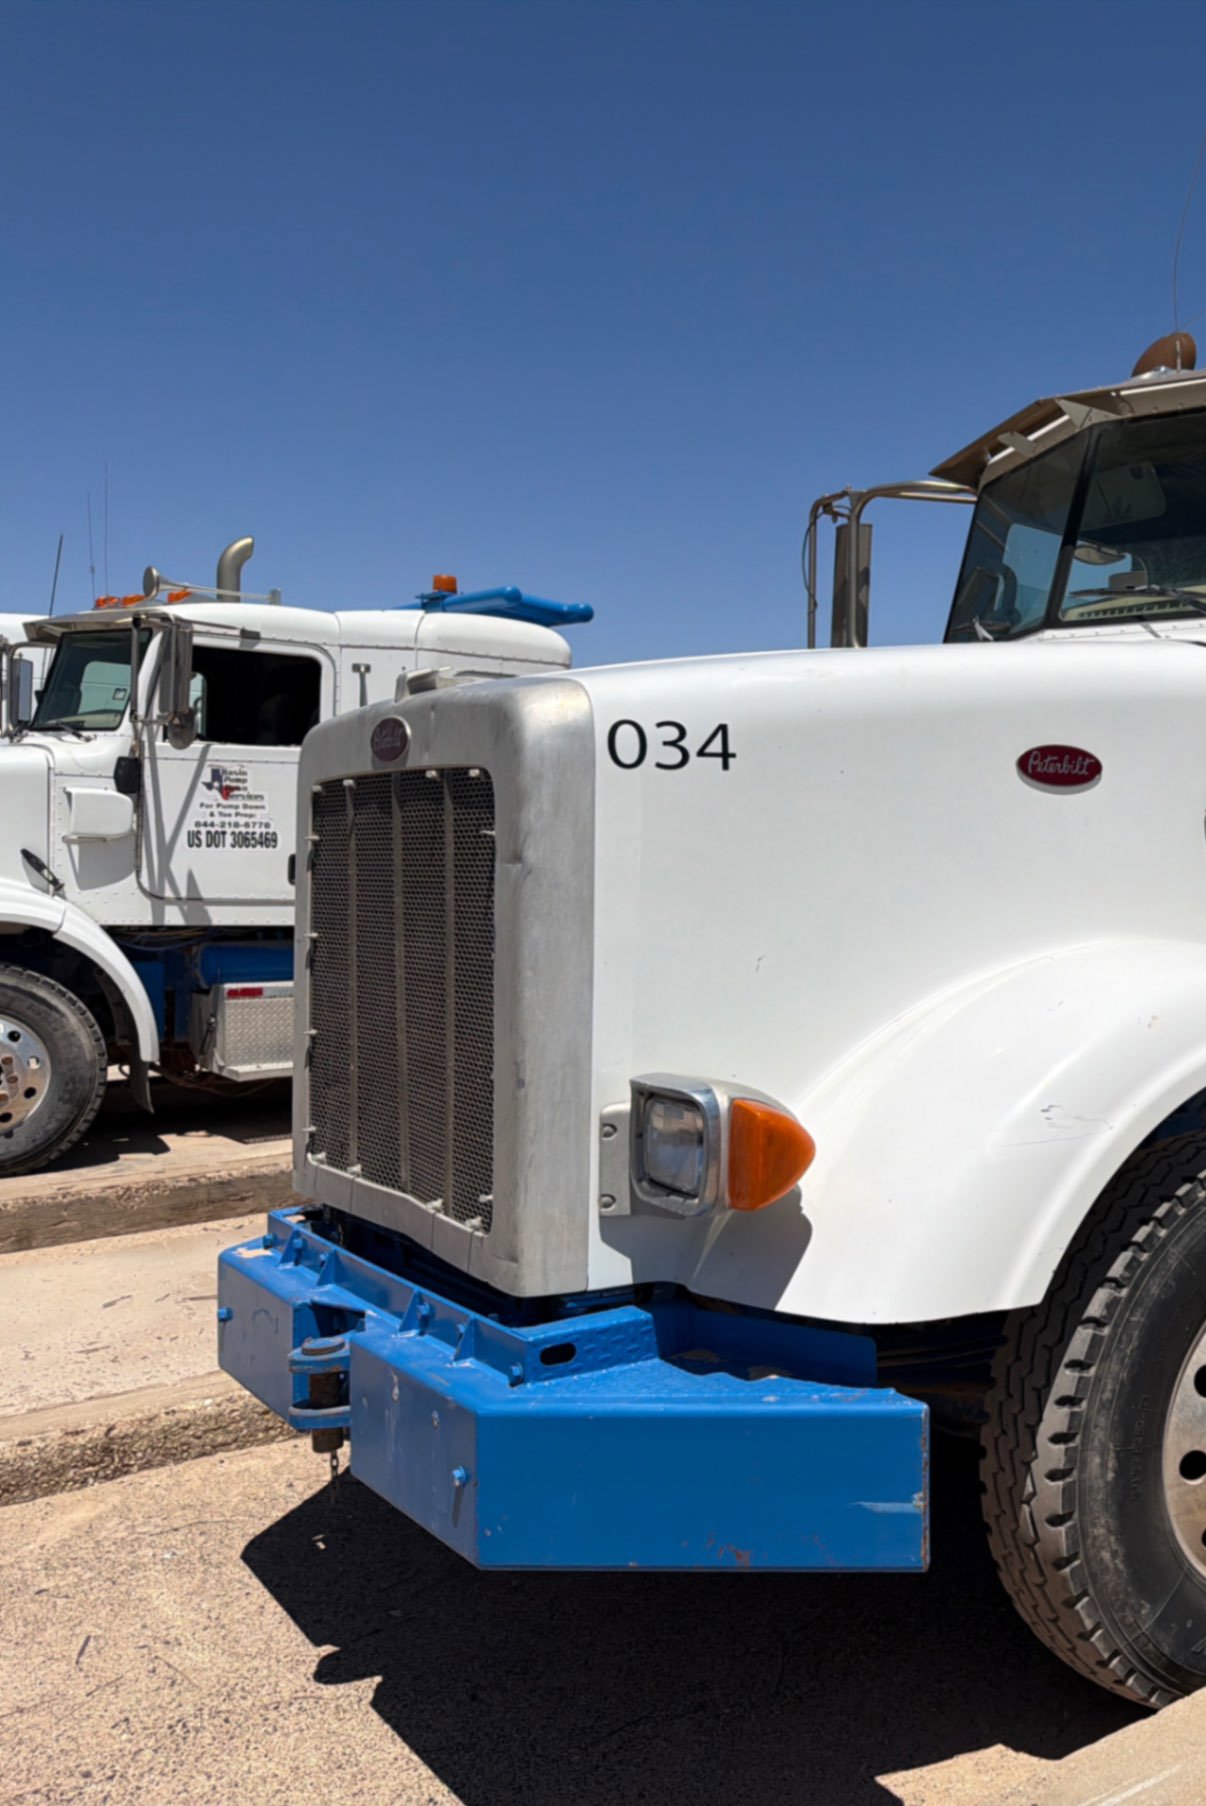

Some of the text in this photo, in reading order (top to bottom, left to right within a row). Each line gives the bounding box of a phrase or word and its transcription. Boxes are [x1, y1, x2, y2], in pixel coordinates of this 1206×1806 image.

[607, 719, 738, 772] 034
[1027, 750, 1096, 776] Peterbilt
[187, 830, 278, 849] US DOT 3065469
